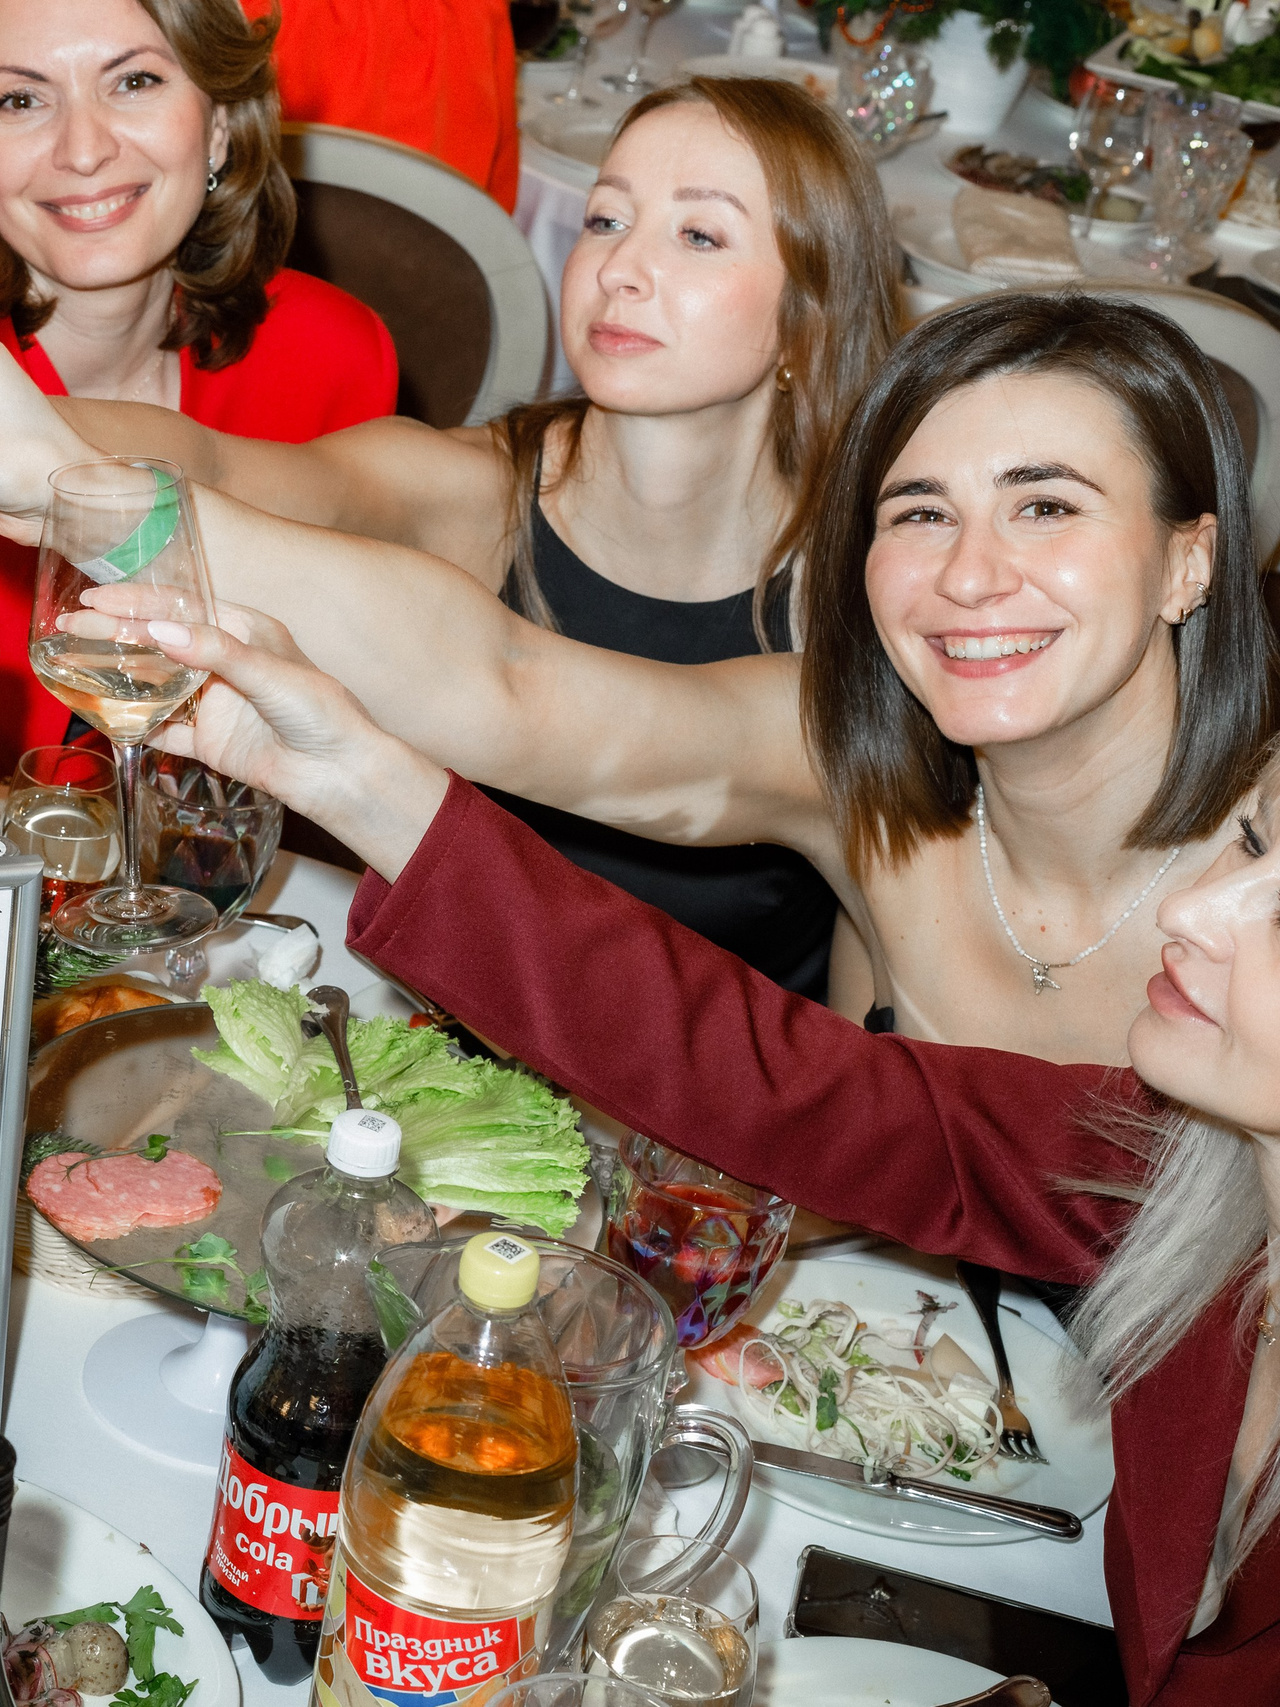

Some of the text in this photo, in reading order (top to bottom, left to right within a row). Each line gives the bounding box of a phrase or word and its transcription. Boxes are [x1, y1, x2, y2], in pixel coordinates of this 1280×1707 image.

[215, 1540, 249, 1582] ПОЛУЧАЙ
[215, 1554, 241, 1587] ПРИЗЫ
[235, 1532, 294, 1572] cola
[354, 1614, 503, 1660] Праздник
